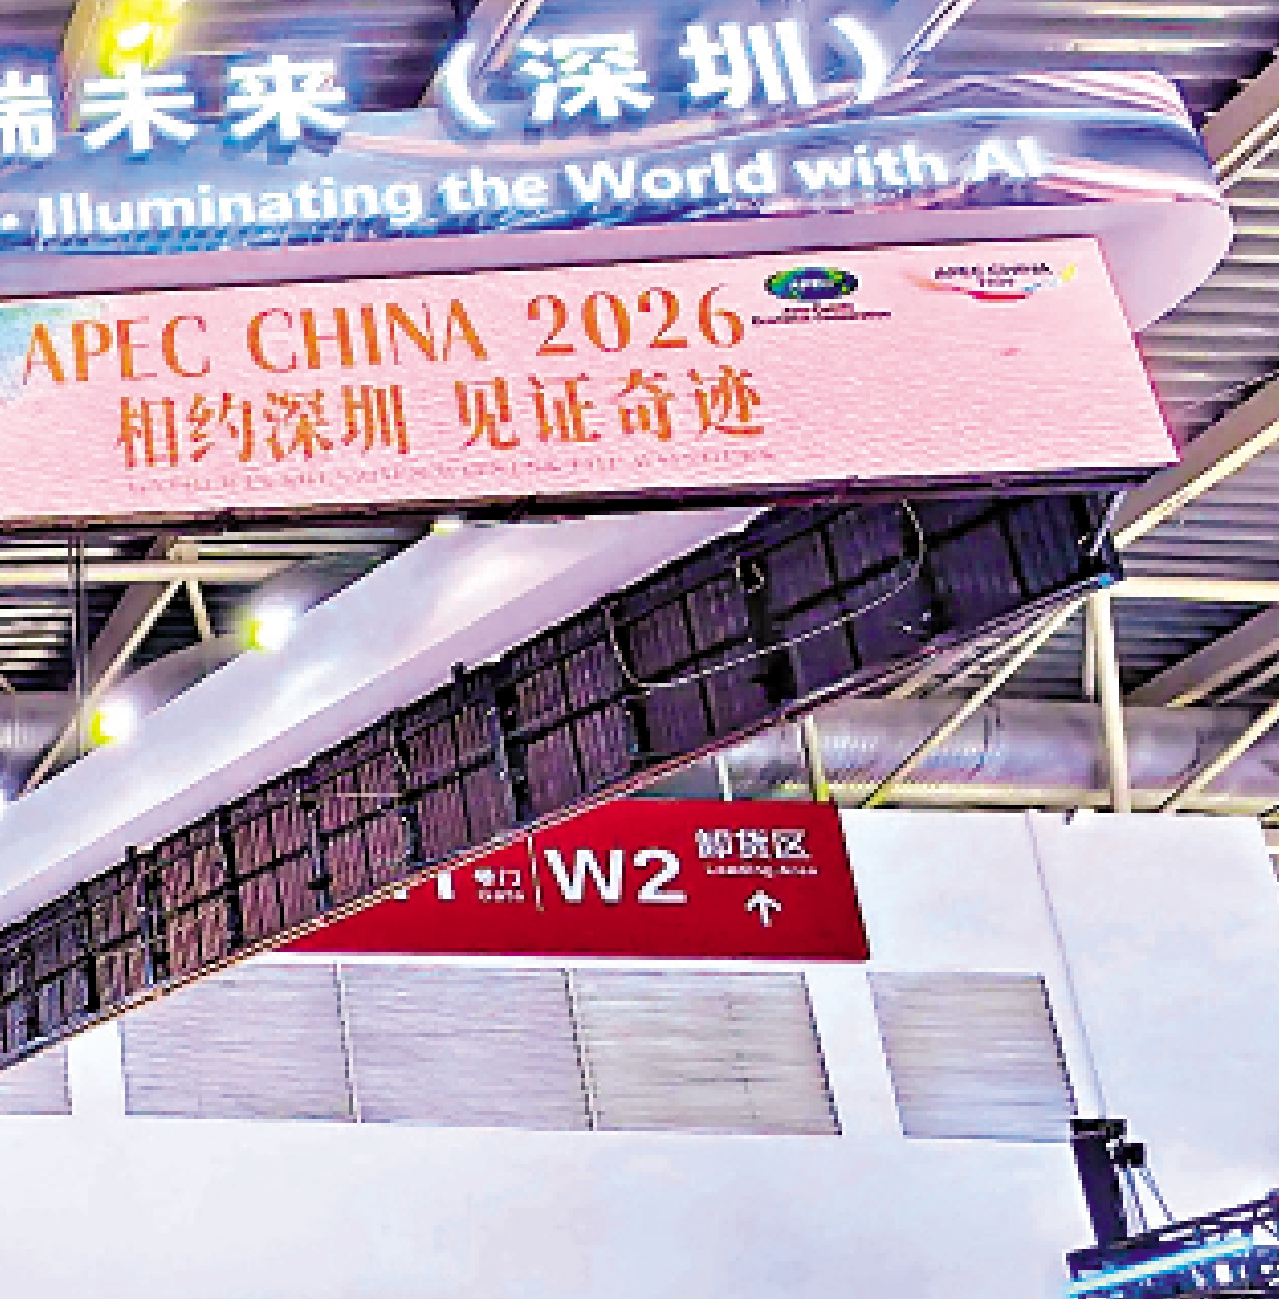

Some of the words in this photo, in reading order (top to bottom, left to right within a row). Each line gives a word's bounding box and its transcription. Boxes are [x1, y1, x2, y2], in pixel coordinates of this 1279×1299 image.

[37, 176, 423, 239] Illuminating
[437, 165, 549, 211] the
[563, 150, 778, 202] World
[793, 144, 949, 191] with
[966, 136, 1043, 182] AI
[22, 315, 211, 386] APEC
[247, 298, 488, 374] CHINA
[527, 283, 745, 356] 2026
[117, 384, 410, 470] 相约深圳
[453, 364, 765, 450] 见证奇迹
[543, 849, 688, 904] W2
